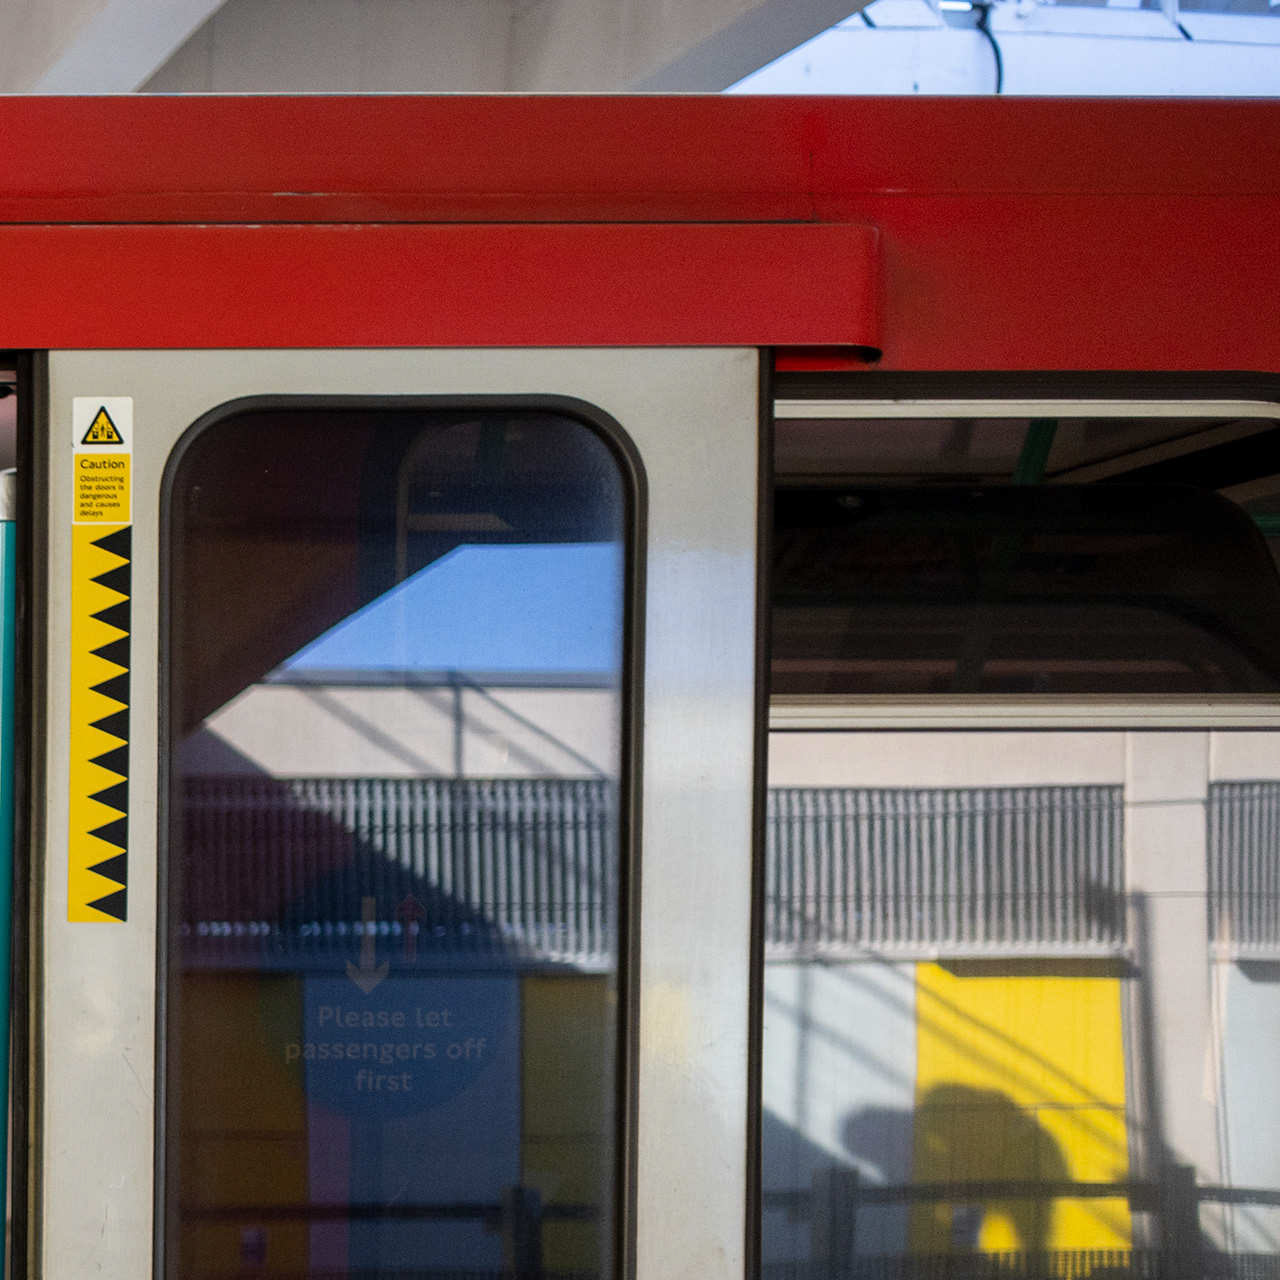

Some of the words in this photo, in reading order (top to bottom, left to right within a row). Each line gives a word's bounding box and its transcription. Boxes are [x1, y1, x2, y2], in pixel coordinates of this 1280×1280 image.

[80, 459, 125, 469] Caution
[79, 475, 124, 483] Obstructing
[79, 510, 103, 518] delays
[318, 1005, 406, 1028] Please
[416, 1006, 453, 1028] let
[285, 1039, 437, 1064] passengers
[446, 1037, 488, 1060] off
[356, 1068, 413, 1091] first
